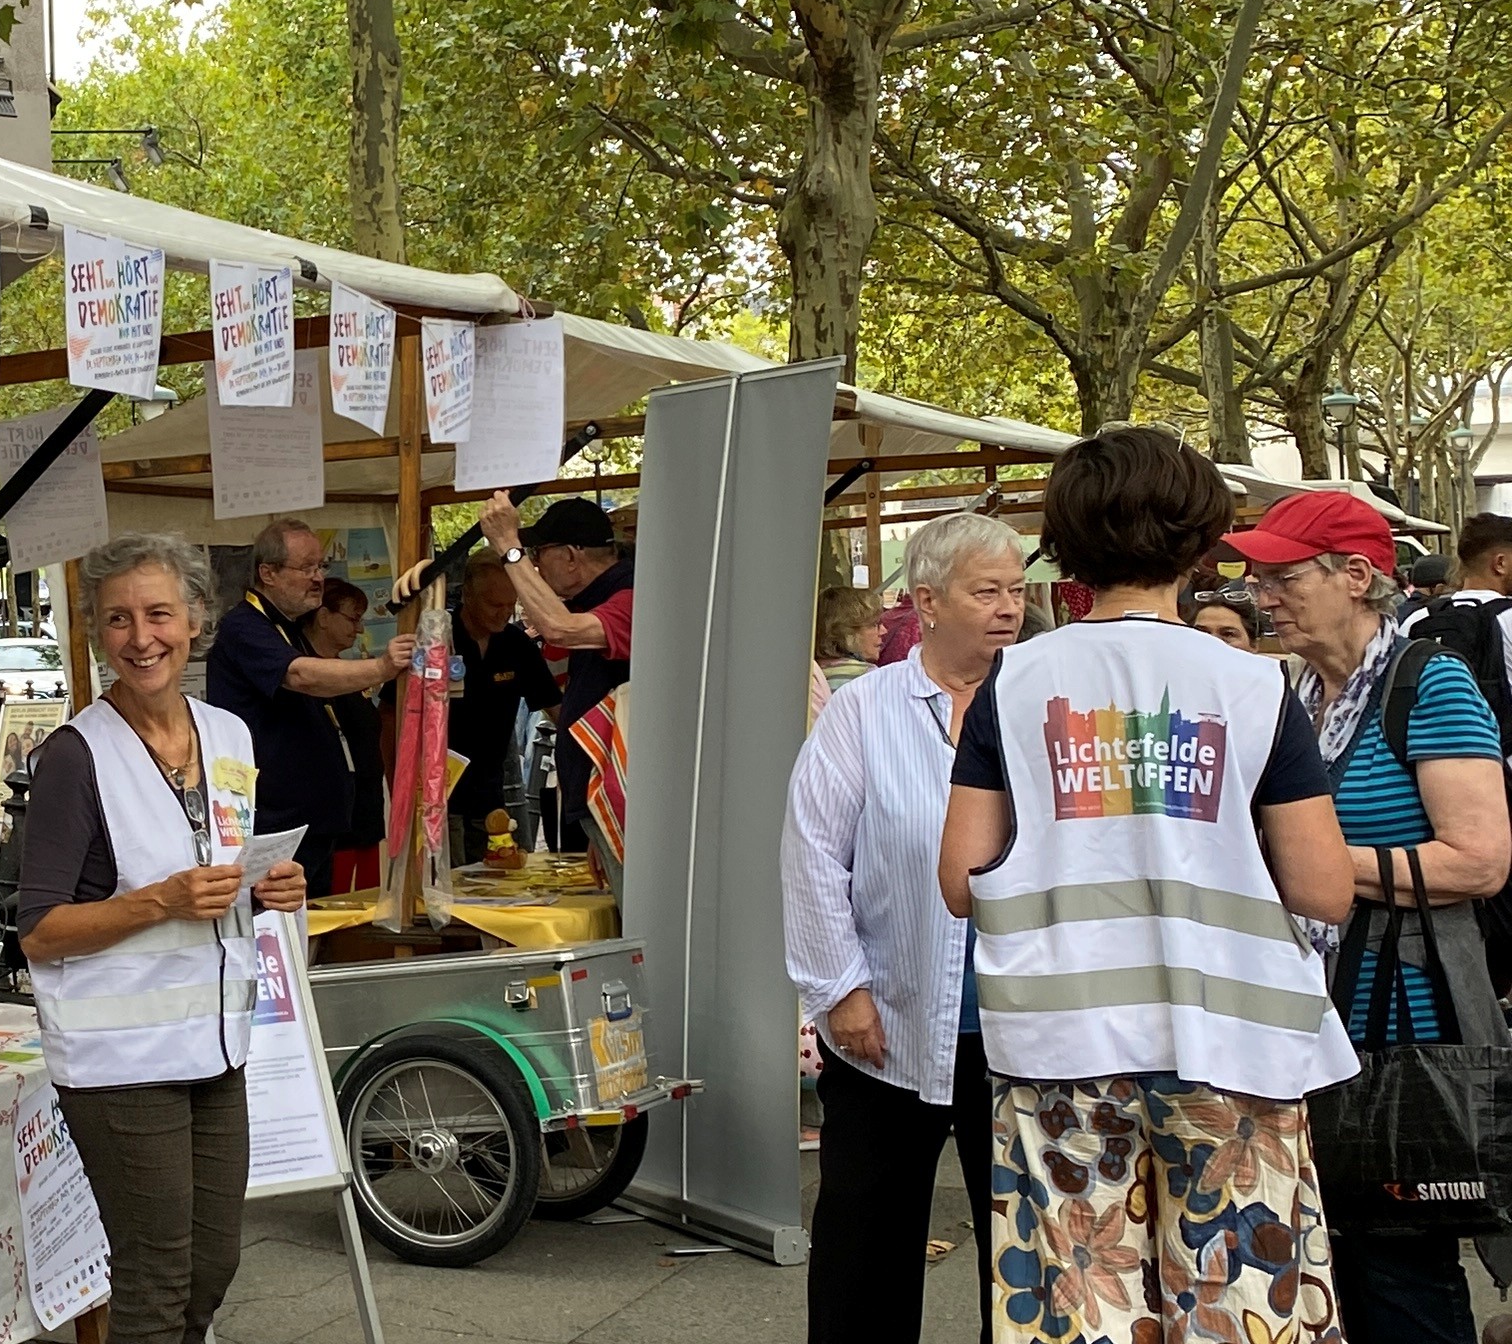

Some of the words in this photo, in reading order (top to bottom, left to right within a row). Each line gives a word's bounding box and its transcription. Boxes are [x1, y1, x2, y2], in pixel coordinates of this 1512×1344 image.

[71, 259, 104, 294] SEHT
[117, 255, 149, 290] HÖRT
[215, 285, 243, 321] SEHT
[252, 275, 278, 311] HÖRT
[334, 311, 358, 338] SEHT
[17, 1109, 42, 1153] SEHT
[24, 1120, 68, 1174] DEMOKR
[1417, 1181, 1486, 1200] SATURN
